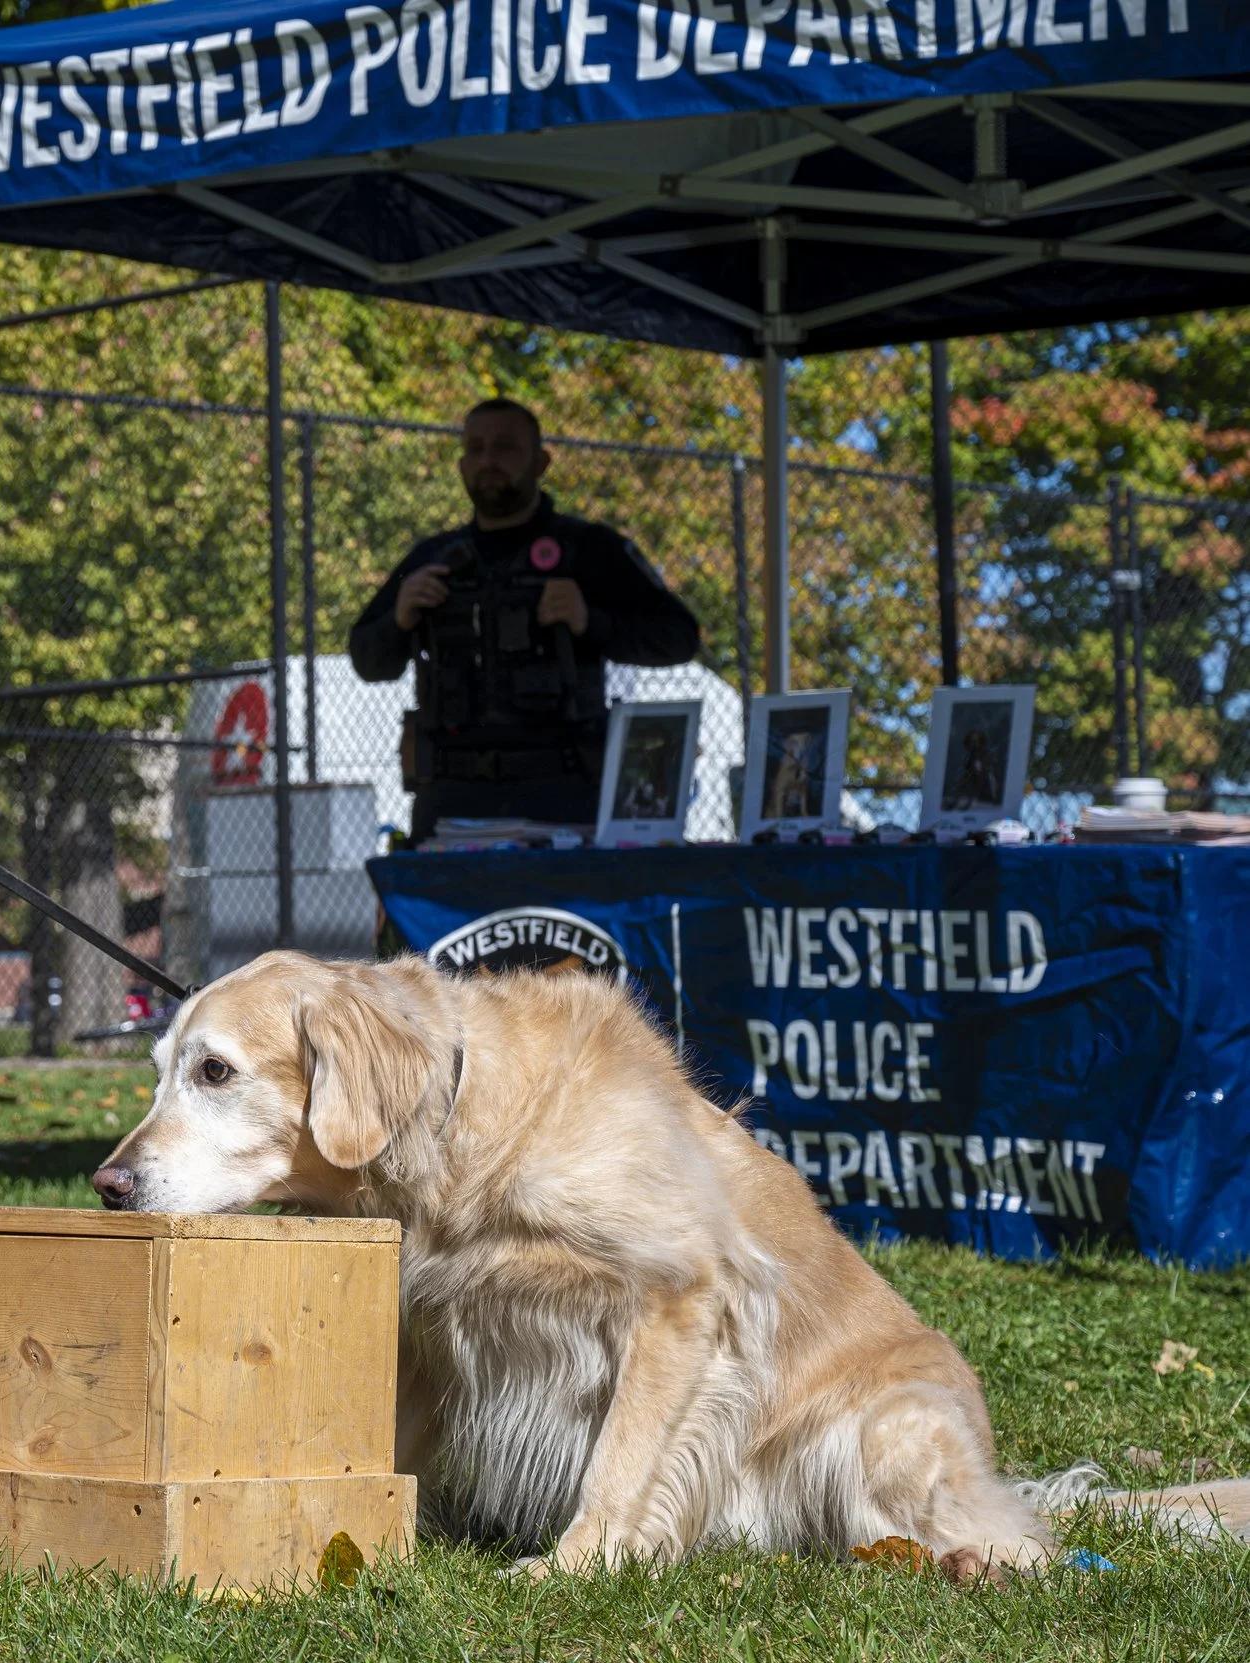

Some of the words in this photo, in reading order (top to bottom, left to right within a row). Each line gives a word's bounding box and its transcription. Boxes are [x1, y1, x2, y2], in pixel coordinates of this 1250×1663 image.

[345, 0, 610, 117] POLICE
[446, 917, 608, 967] WESTFIELD
[743, 906, 1048, 994] WESTFIELD
[746, 1018, 941, 1103] POLICE
